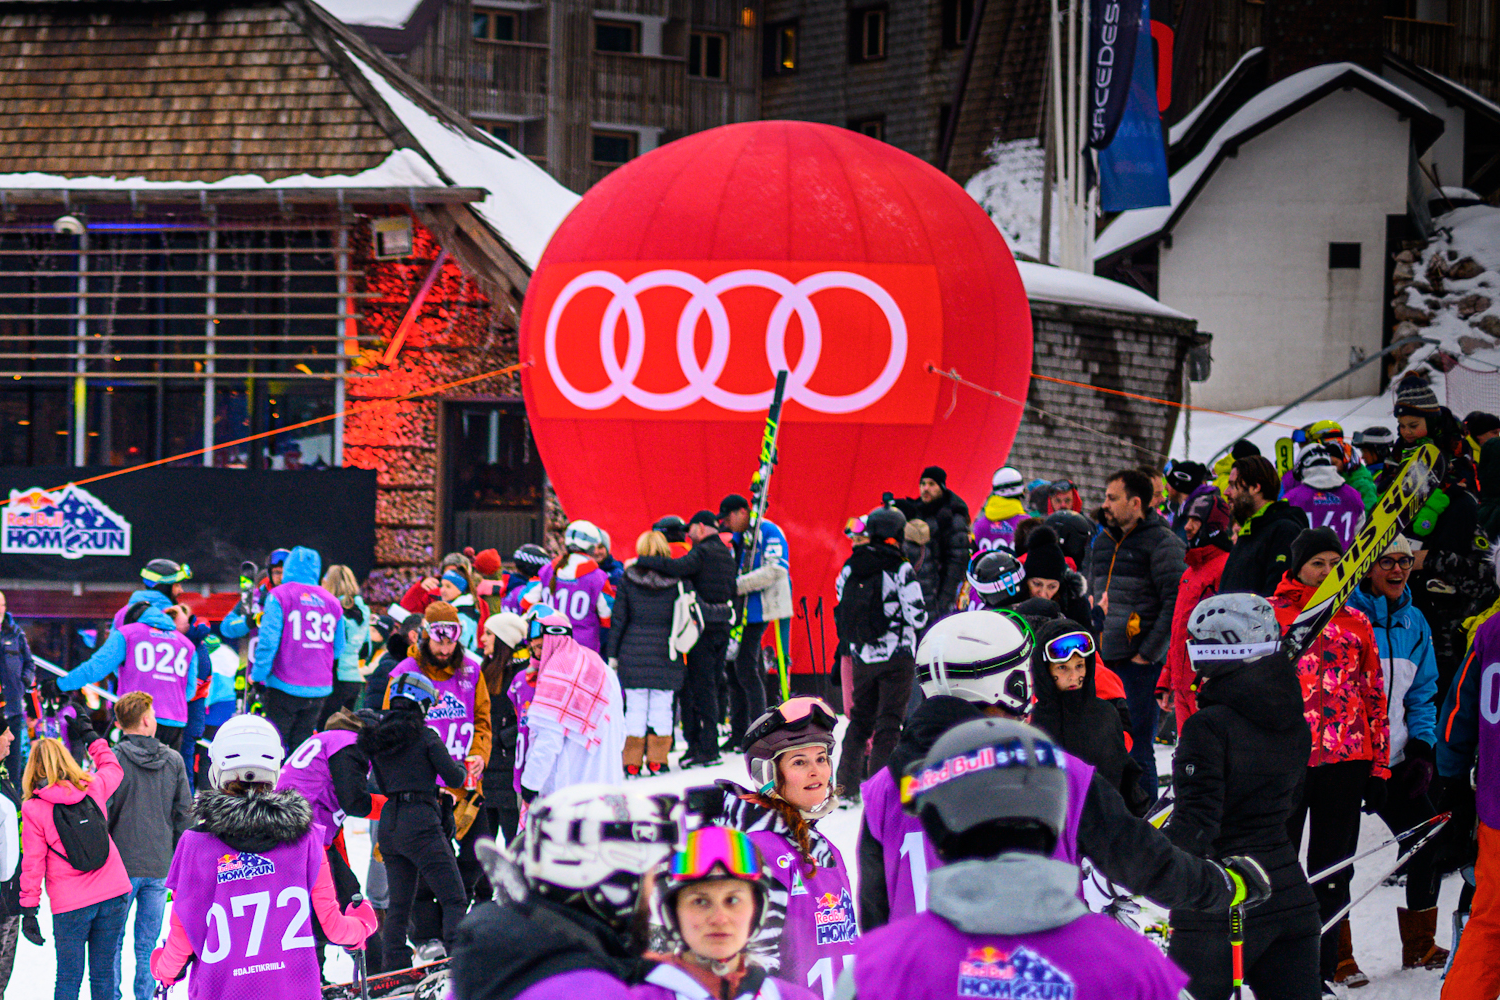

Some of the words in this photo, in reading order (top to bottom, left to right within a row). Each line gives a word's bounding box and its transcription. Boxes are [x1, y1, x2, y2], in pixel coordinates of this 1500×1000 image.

[7, 513, 33, 526] Red
[36, 511, 63, 526] Bull
[1331, 522, 1396, 614] ALLROUND
[287, 609, 337, 643] 133
[135, 641, 188, 677] 026
[921, 760, 950, 789] Red
[951, 747, 995, 777] Bull
[201, 886, 315, 964] 072
